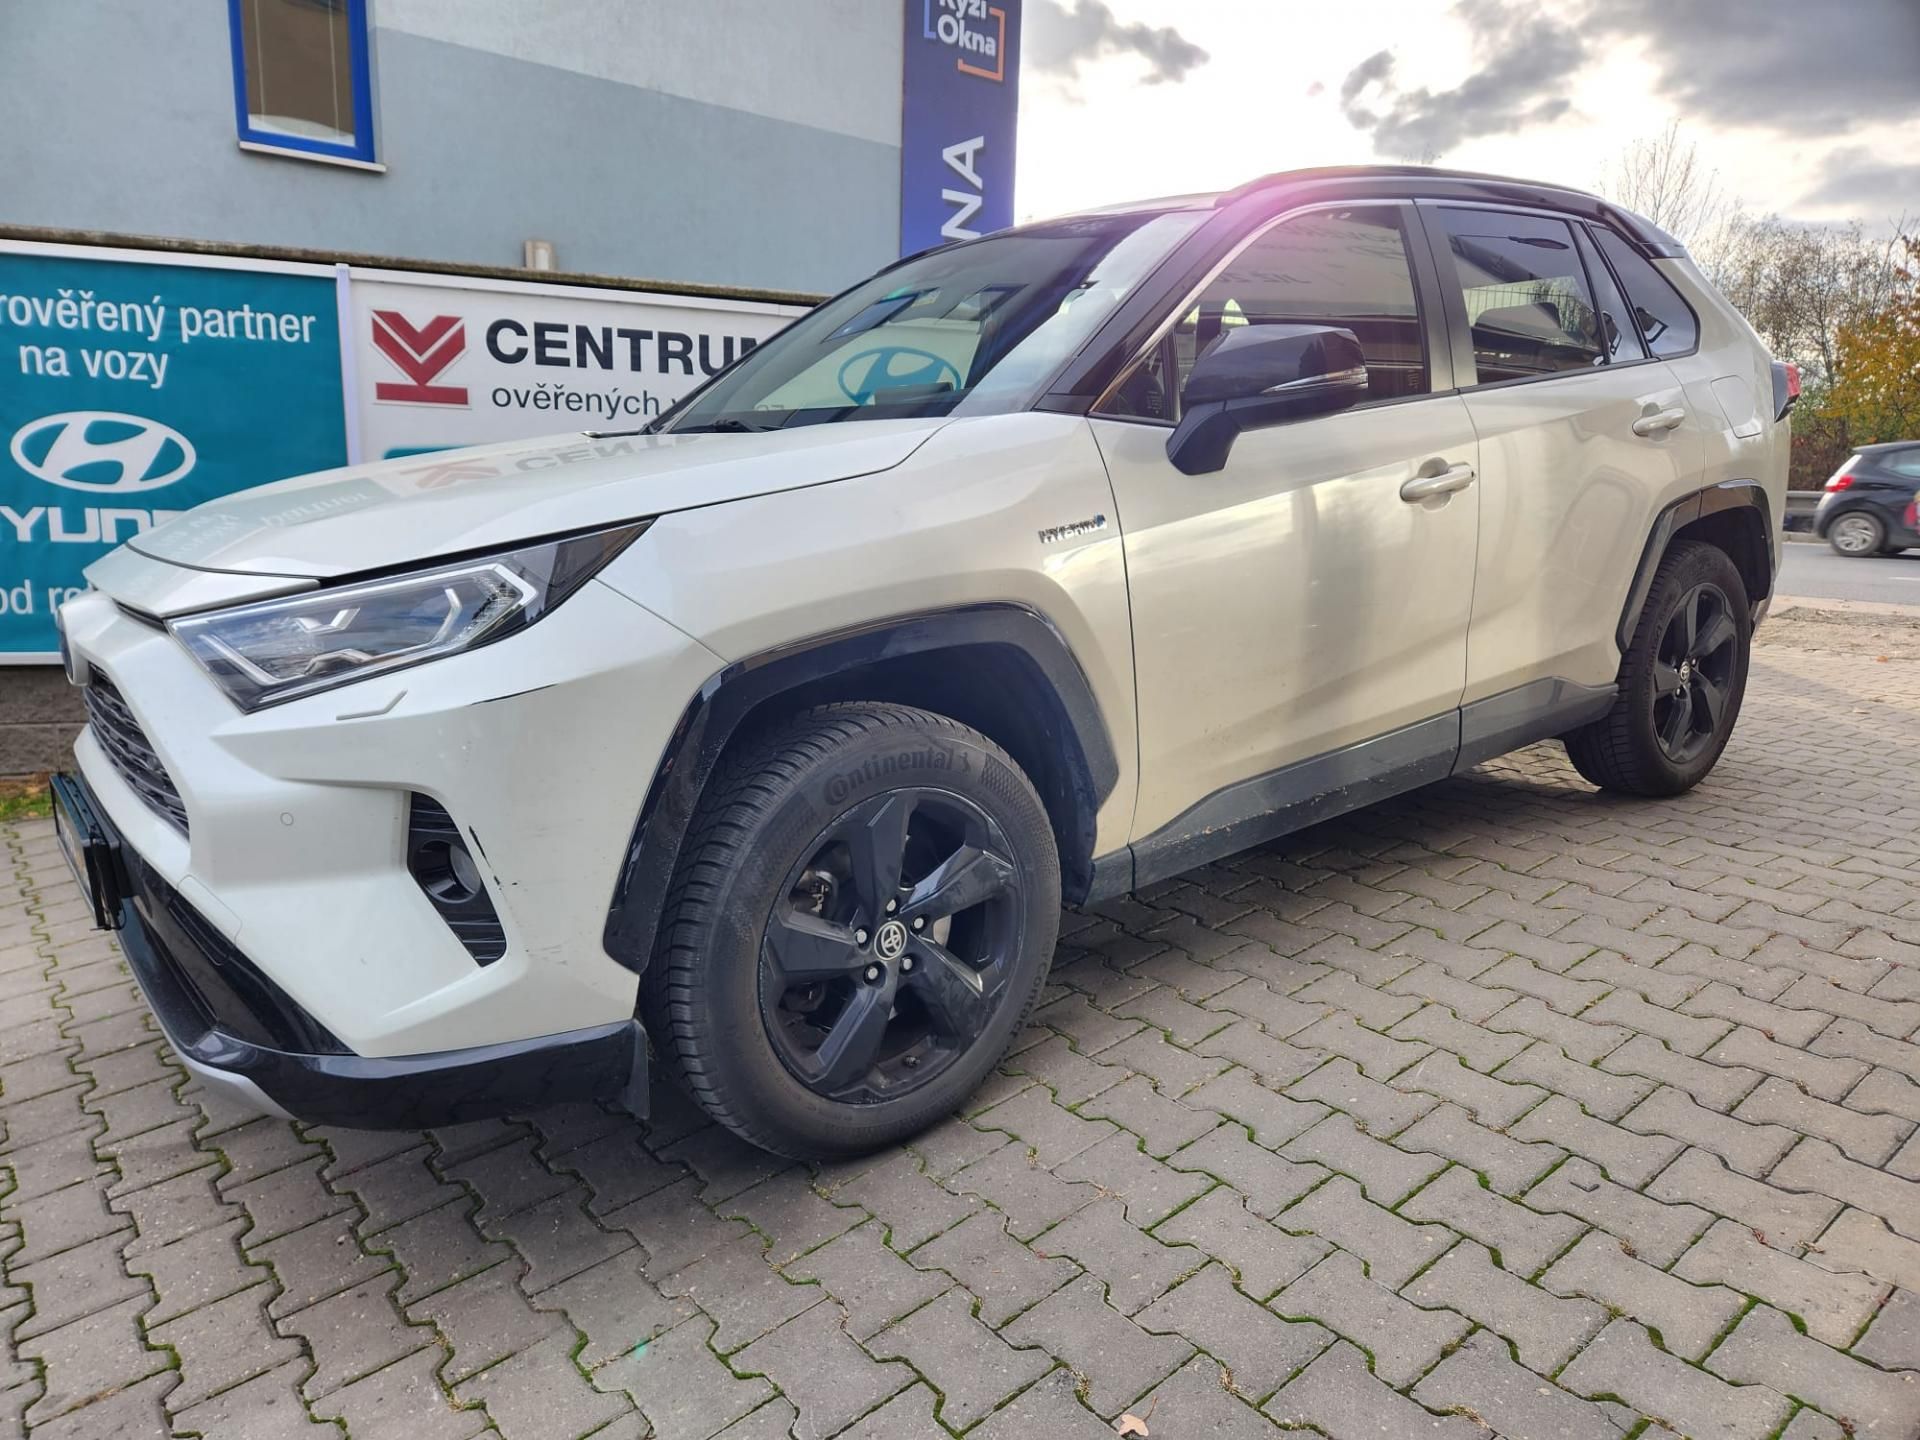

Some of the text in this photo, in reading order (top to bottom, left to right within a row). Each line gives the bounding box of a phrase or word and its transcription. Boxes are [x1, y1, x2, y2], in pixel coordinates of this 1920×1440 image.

[937, 14, 997, 57] Okna
[179, 304, 317, 343] partner
[19, 345, 169, 389] na vozy
[486, 318, 758, 377] CENTRU
[491, 382, 660, 420] ověřených
[0, 505, 186, 543] YUN
[823, 747, 955, 806] Continental
